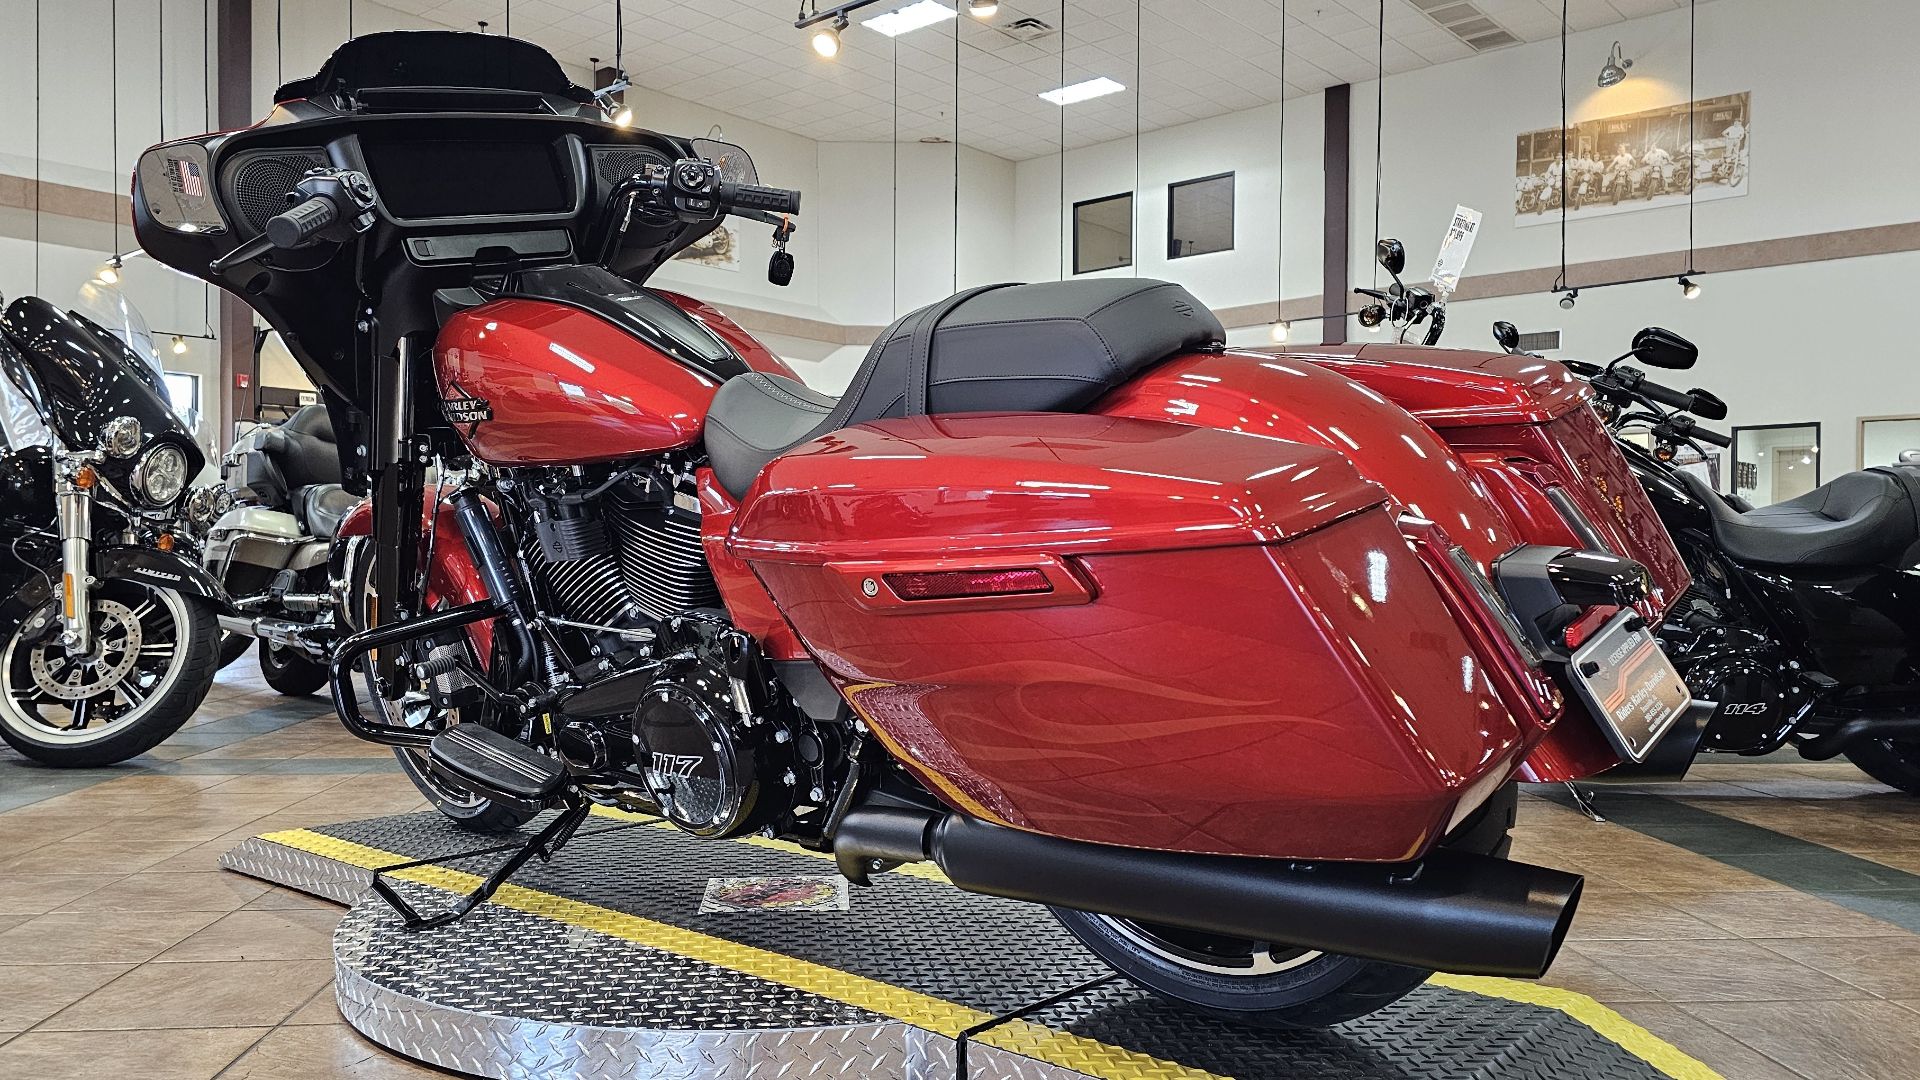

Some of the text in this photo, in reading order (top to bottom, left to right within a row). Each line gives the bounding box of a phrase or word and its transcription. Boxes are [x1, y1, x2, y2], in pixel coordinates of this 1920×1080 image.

[1608, 647, 1624, 666] LICENSE
[1615, 699, 1635, 722] Riders
[1630, 667, 1667, 707] Harley-Davidson
[1723, 702, 1768, 714] 114
[651, 751, 704, 779] 117
